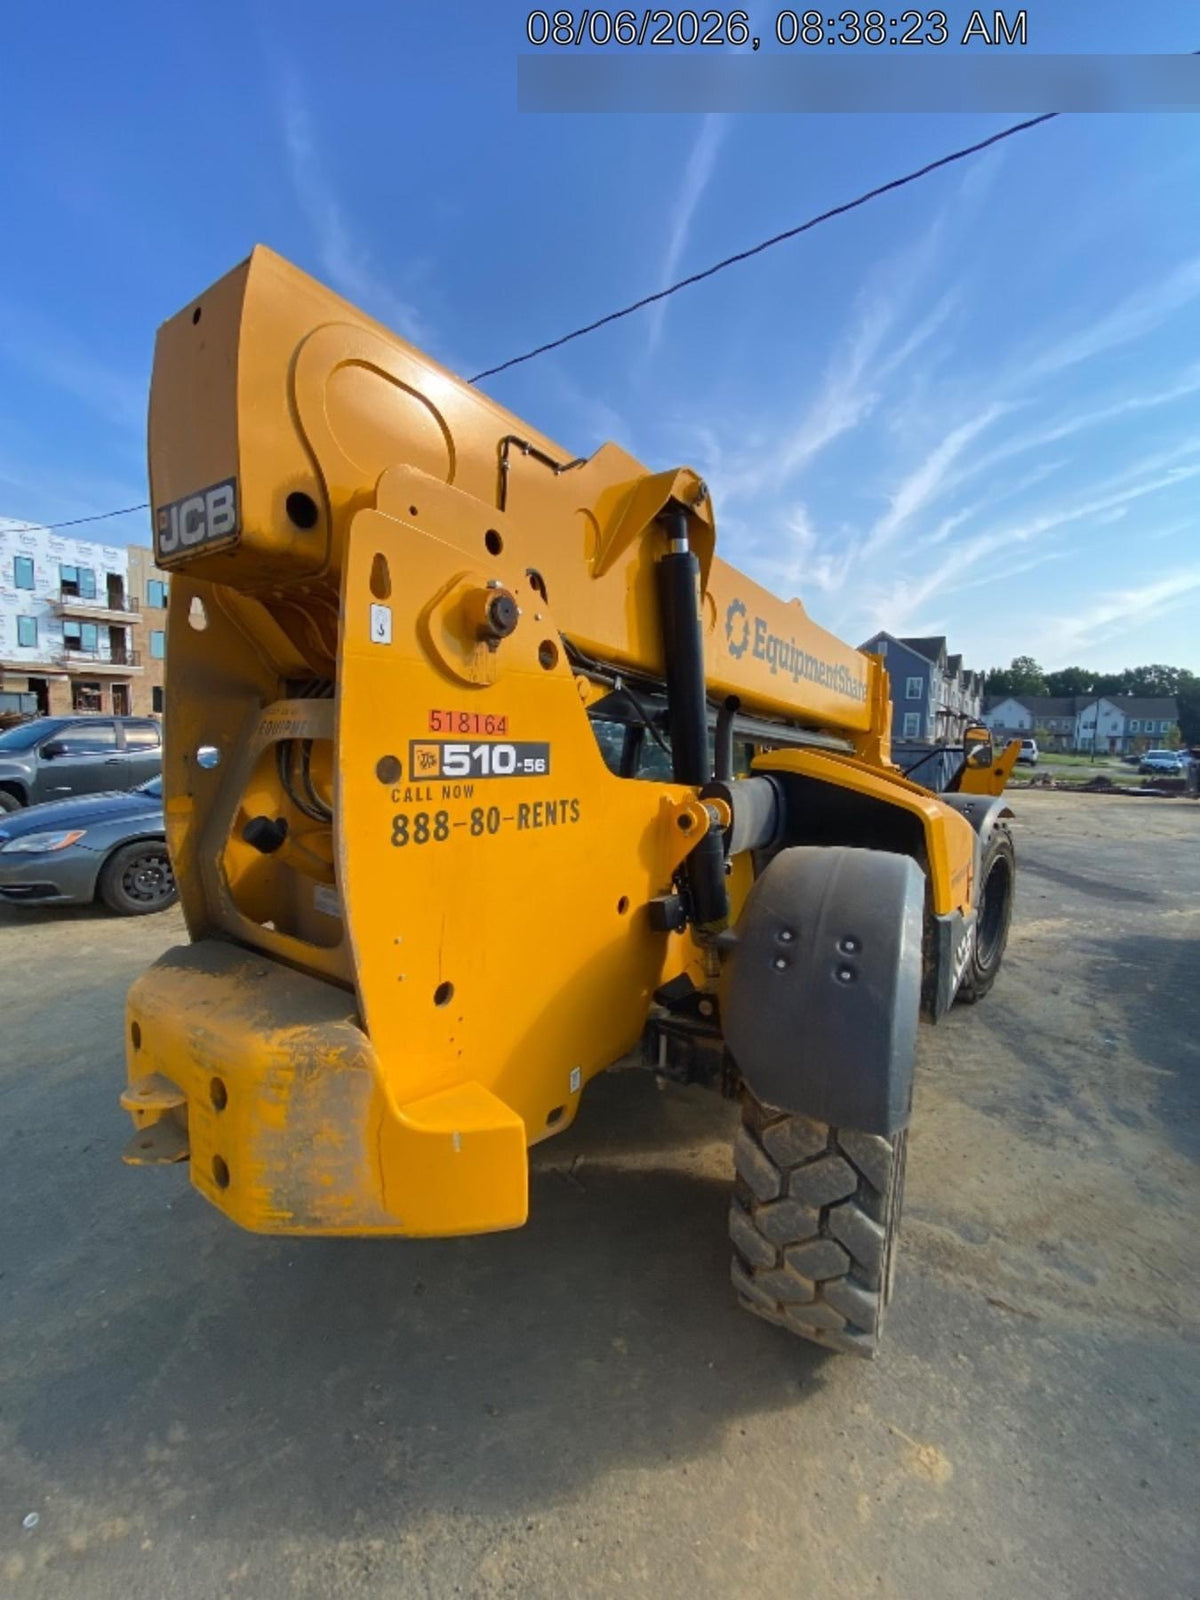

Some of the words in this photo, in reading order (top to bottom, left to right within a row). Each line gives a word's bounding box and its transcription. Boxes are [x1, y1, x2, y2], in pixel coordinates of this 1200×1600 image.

[160, 485, 235, 553] JCB
[429, 710, 507, 735] 518164
[391, 786, 432, 803] CALL
[441, 785, 474, 799] NOW
[390, 798, 580, 847] 888-80-RENTS
